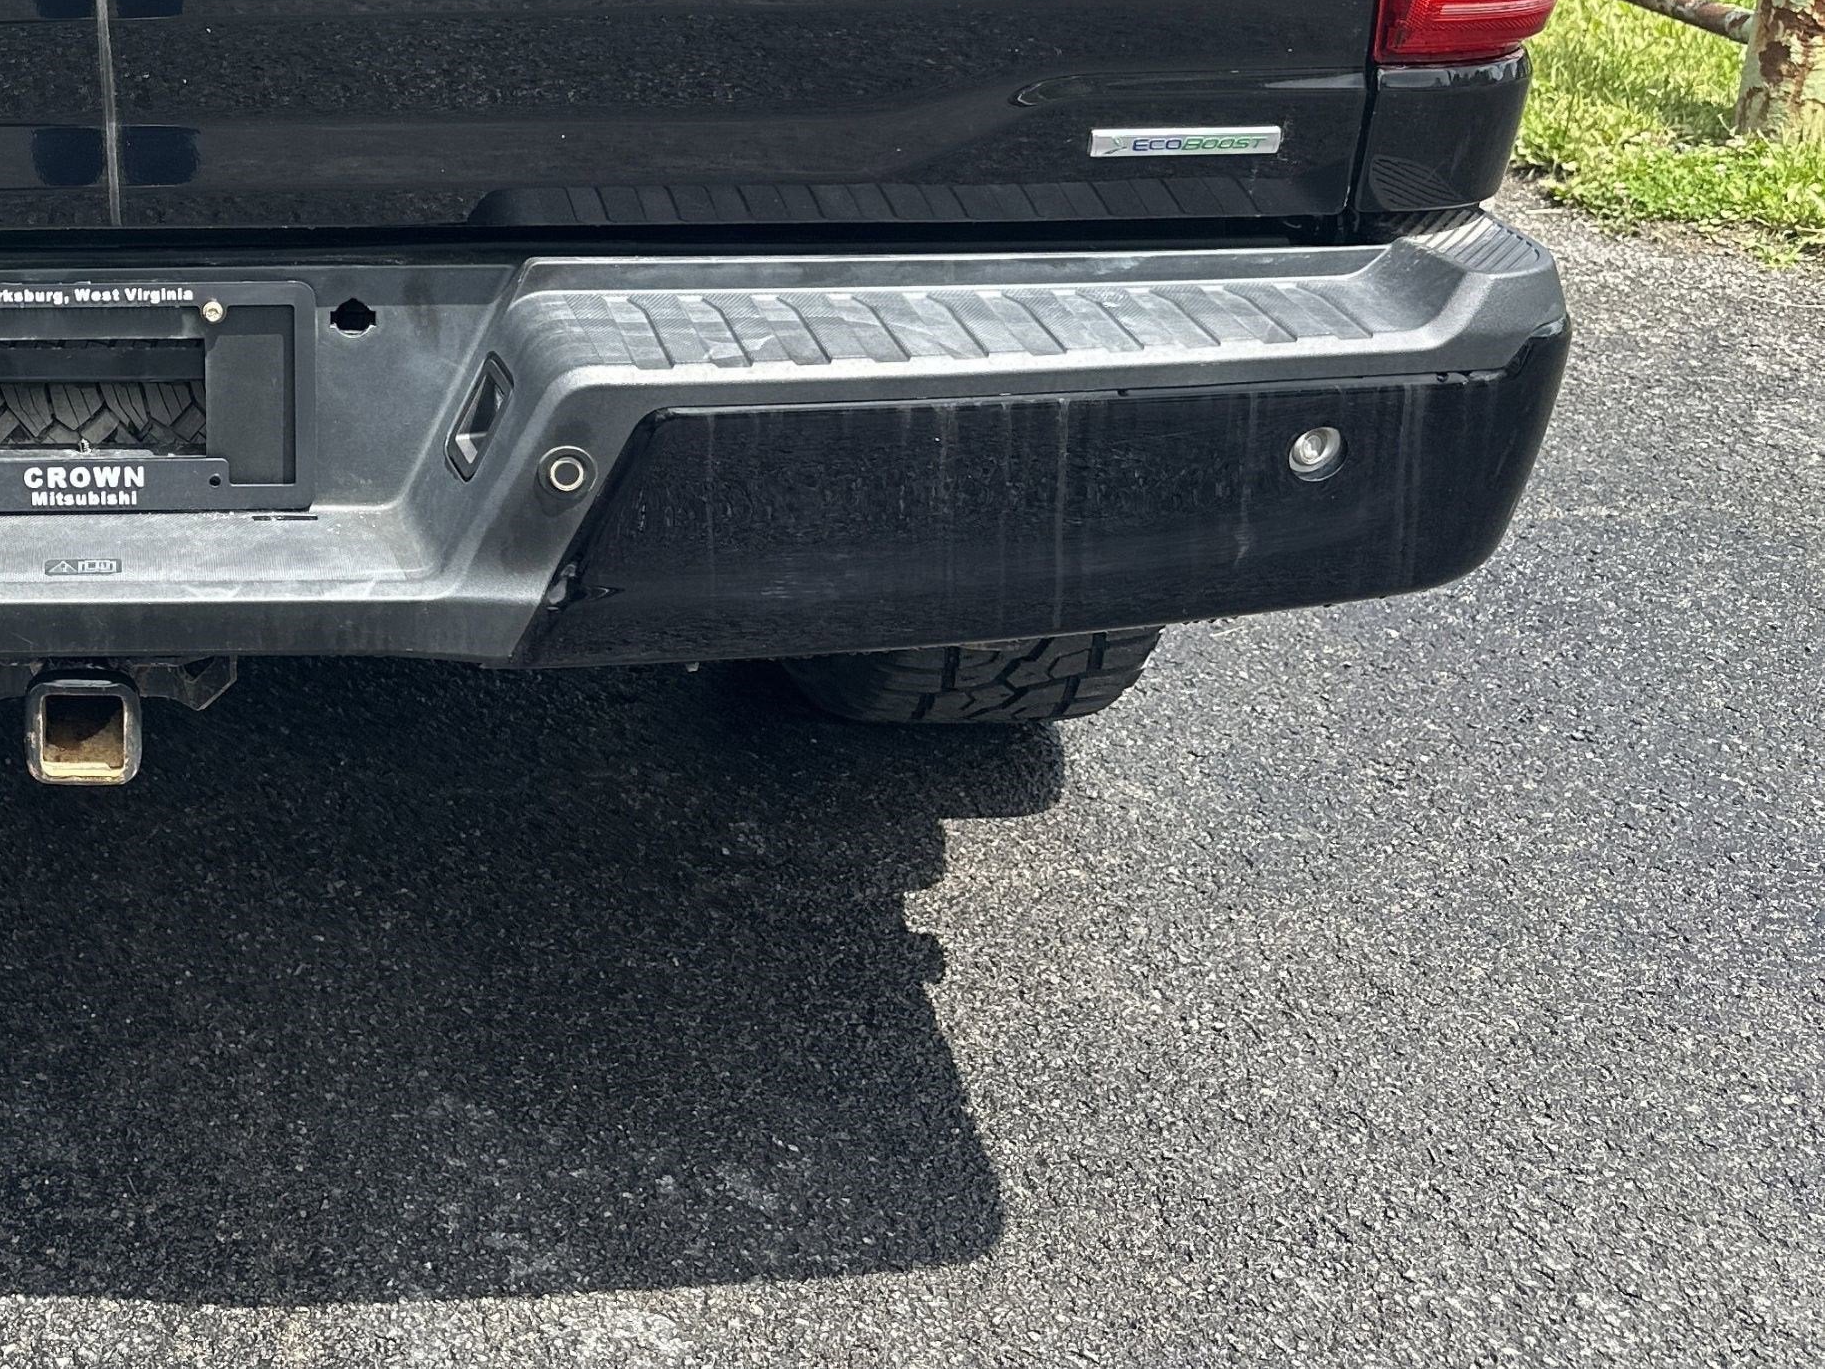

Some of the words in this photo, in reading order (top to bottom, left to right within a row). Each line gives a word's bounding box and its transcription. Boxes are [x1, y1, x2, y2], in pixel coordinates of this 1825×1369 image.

[1131, 136, 1267, 152] ECOBOOST
[74, 287, 121, 303] West
[123, 287, 194, 304] Virginia
[23, 466, 145, 489] CROWN
[31, 490, 137, 506] Mitsubishi
